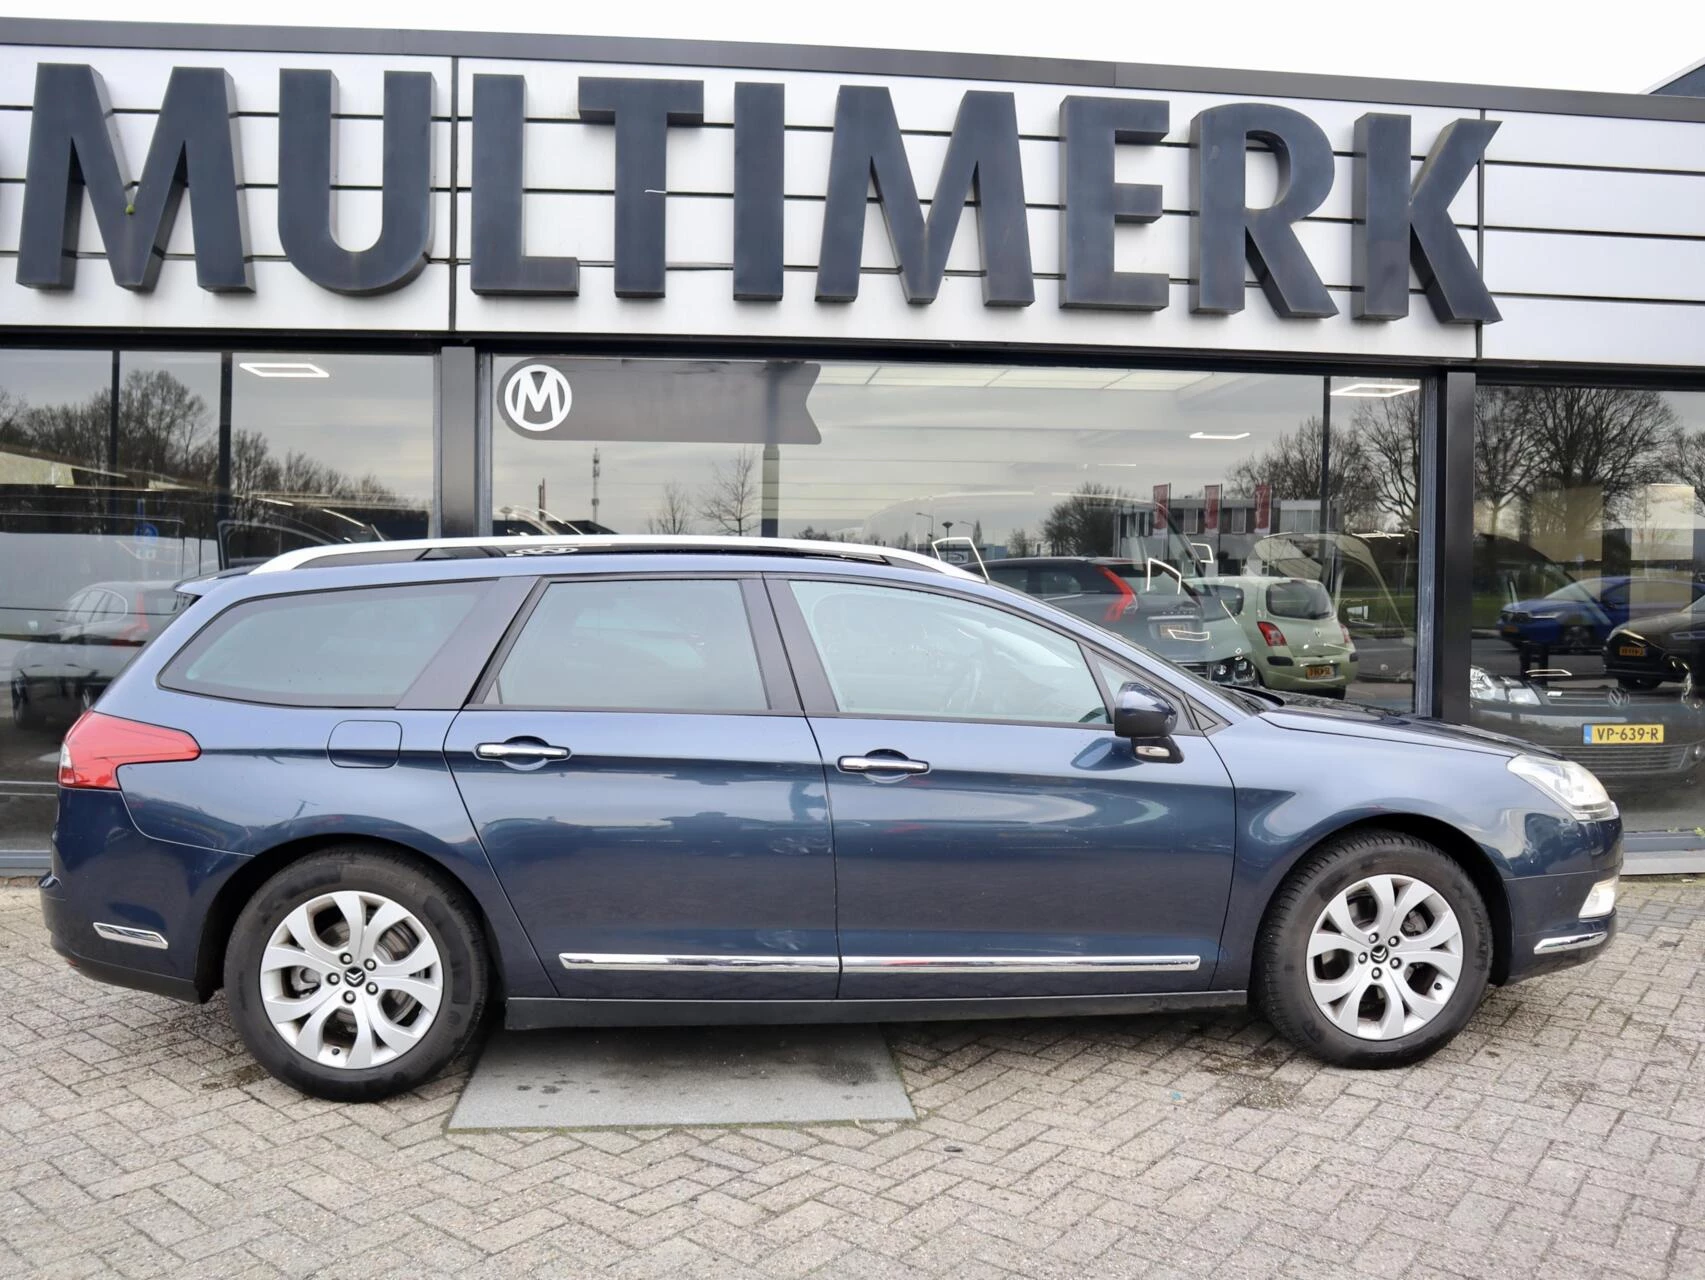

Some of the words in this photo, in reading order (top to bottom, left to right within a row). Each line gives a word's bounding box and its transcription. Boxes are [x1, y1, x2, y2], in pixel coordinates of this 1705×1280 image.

[16, 62, 1503, 325] MULTIMERK
[509, 364, 568, 428] M
[1596, 727, 1659, 741] VP-639-R
